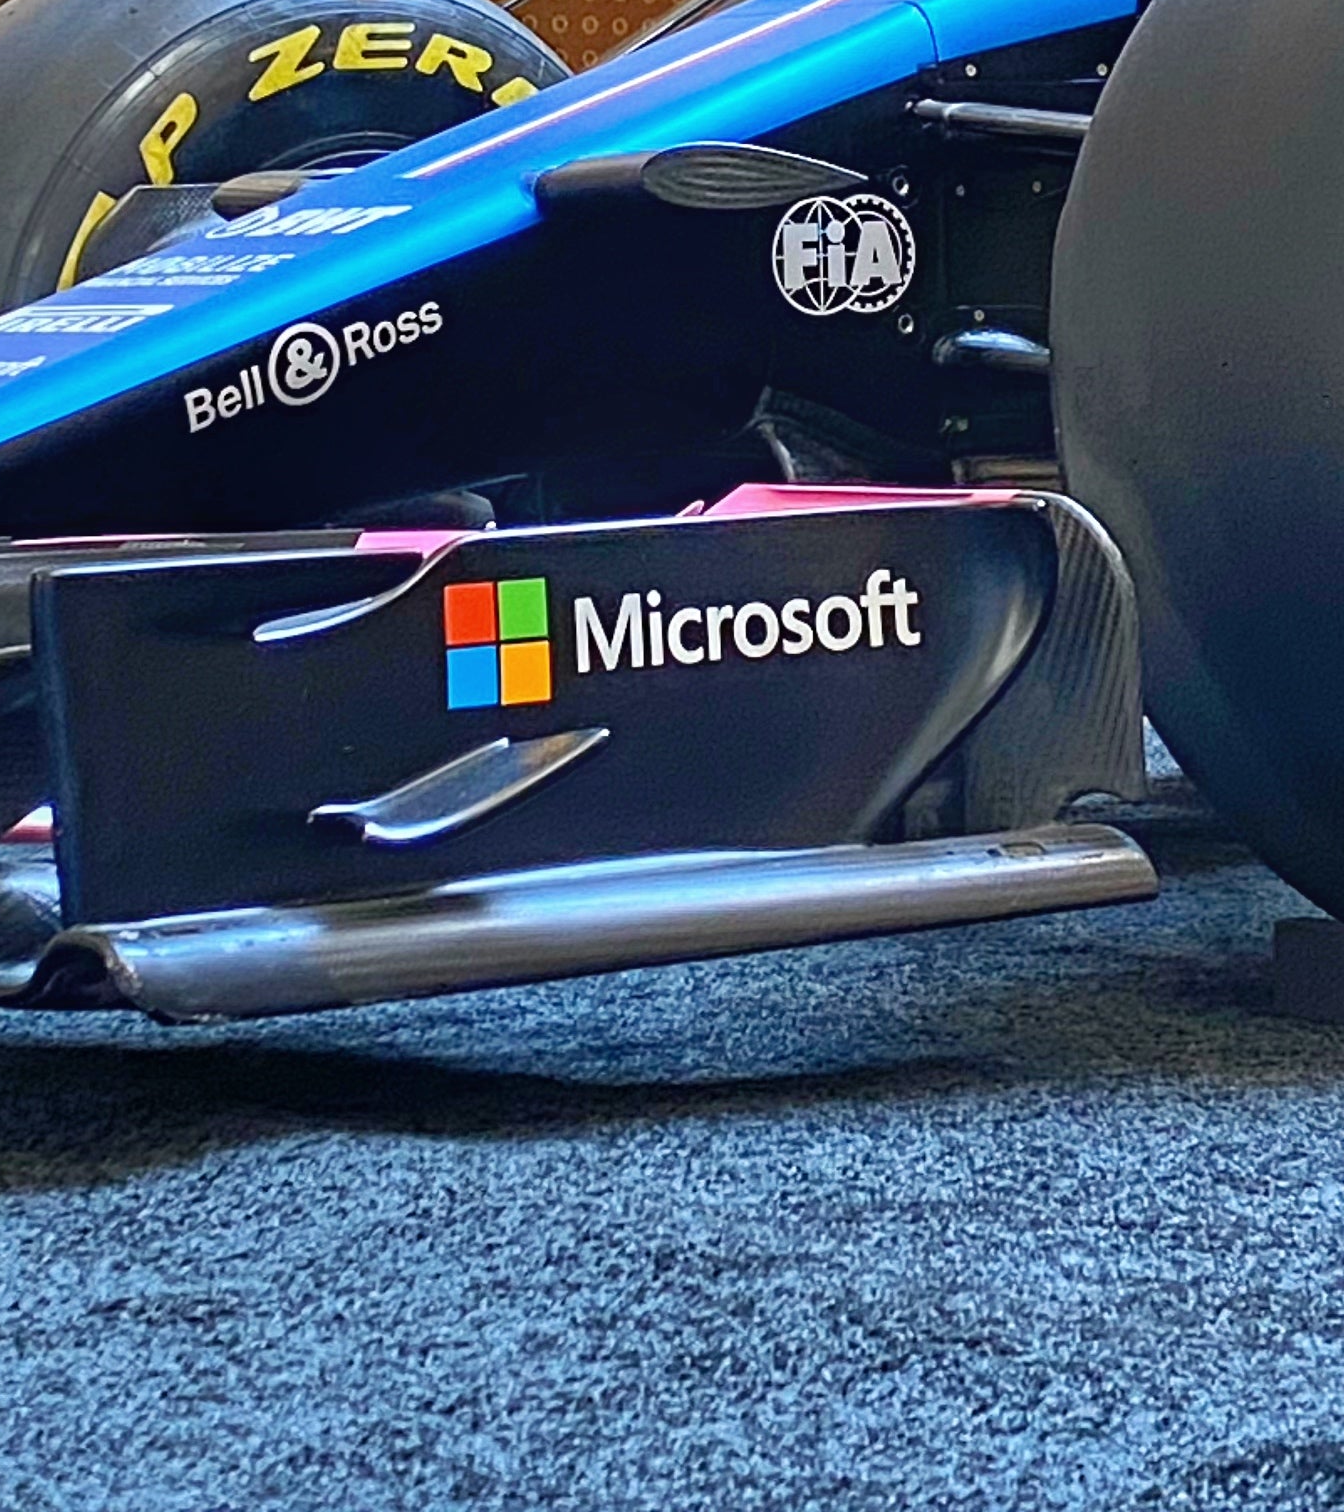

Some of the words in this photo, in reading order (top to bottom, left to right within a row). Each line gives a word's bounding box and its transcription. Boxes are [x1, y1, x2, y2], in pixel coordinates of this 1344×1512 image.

[139, 92, 198, 185] P
[244, 205, 412, 238] BWT
[184, 367, 263, 432] Bell
[344, 300, 443, 365] Ross
[573, 568, 921, 674] Microsoft
